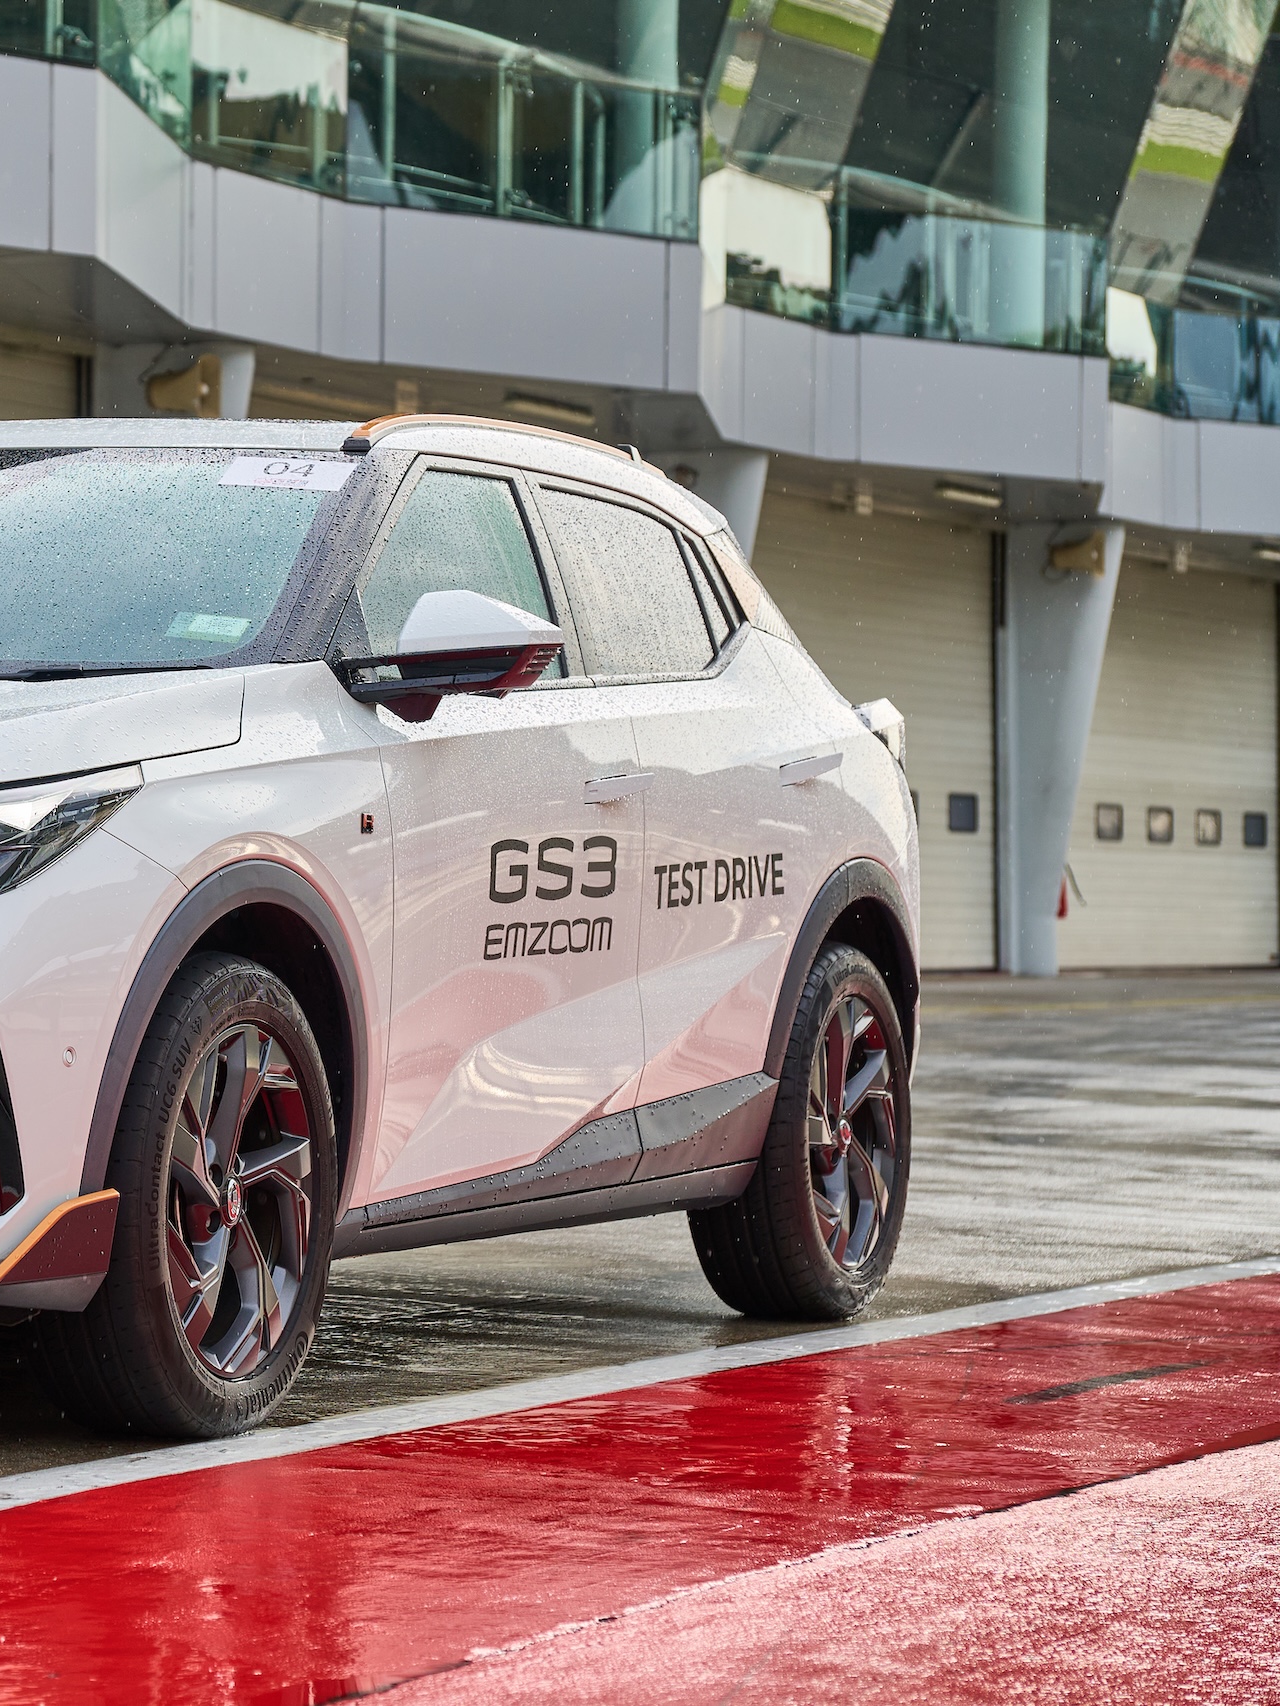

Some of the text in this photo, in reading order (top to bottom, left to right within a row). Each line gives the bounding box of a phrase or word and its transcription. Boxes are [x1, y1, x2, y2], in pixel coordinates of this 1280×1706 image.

[263, 461, 315, 477] 04
[489, 835, 618, 904] GS3
[654, 852, 785, 909] TEST DRIVE
[483, 916, 613, 961] EMZOOM
[144, 1037, 192, 1271] UltraContact UC6 SUV
